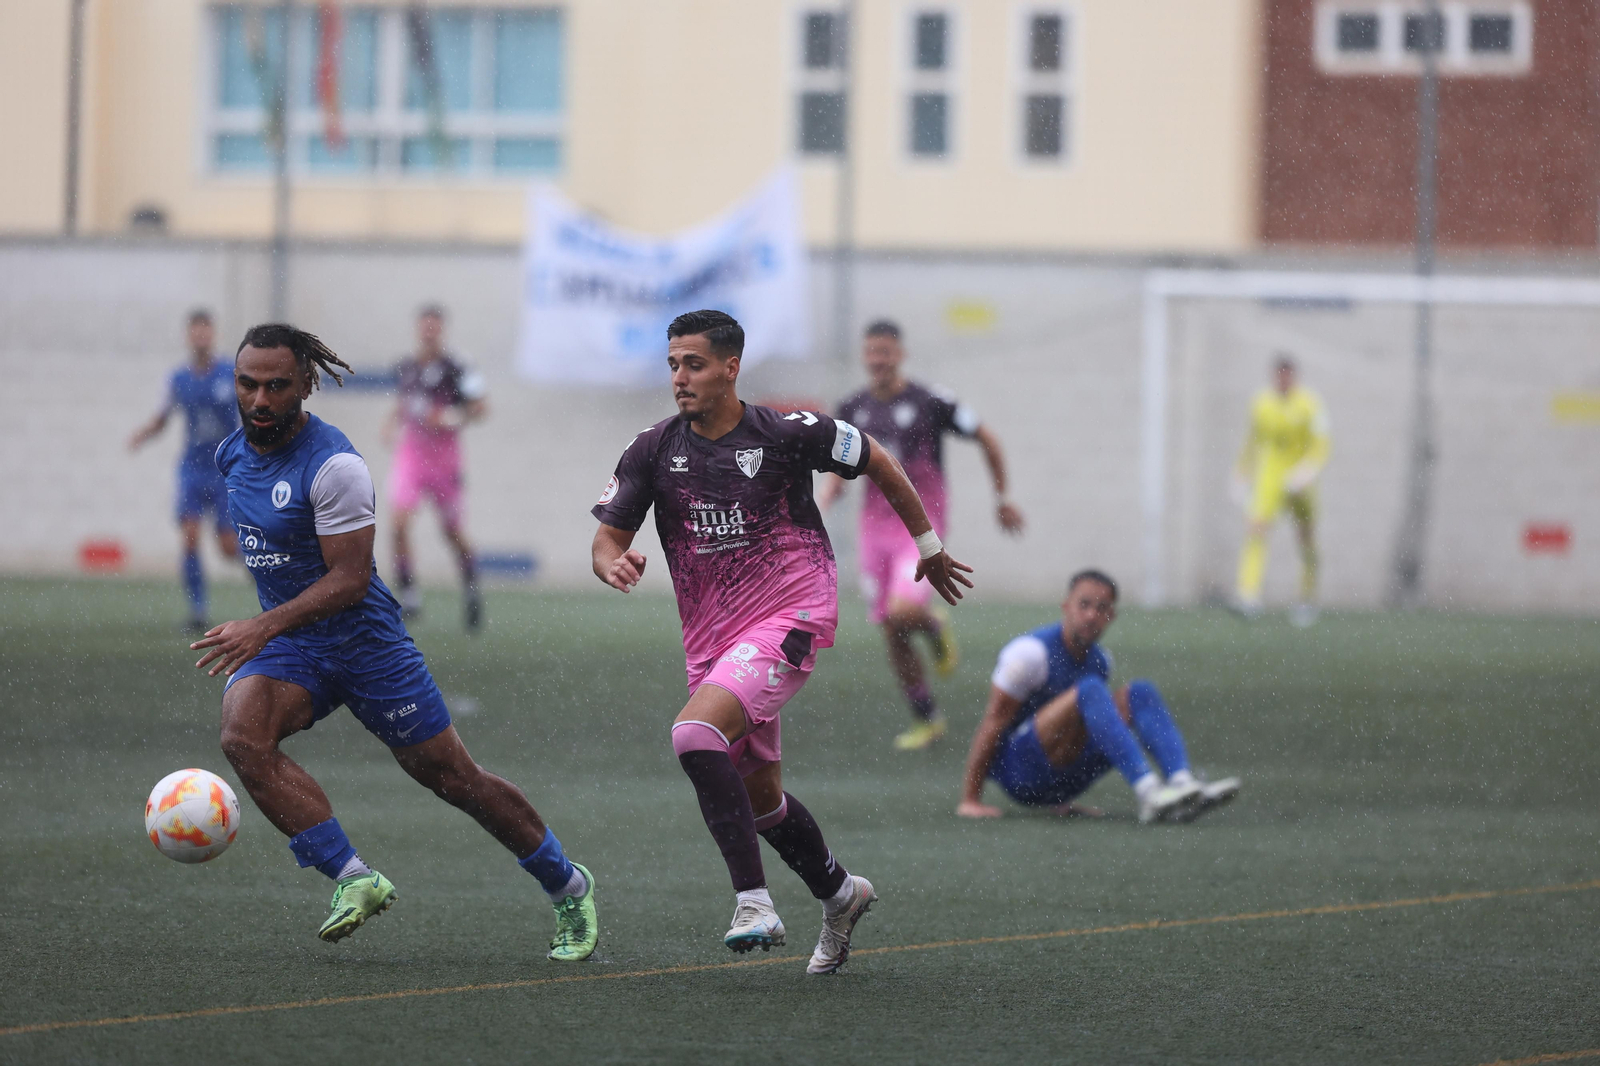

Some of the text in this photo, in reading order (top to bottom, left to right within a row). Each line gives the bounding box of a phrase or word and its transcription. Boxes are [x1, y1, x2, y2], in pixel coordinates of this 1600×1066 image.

[688, 500, 716, 510] sabor
[690, 510, 698, 519] a
[723, 540, 750, 550] Provincia
